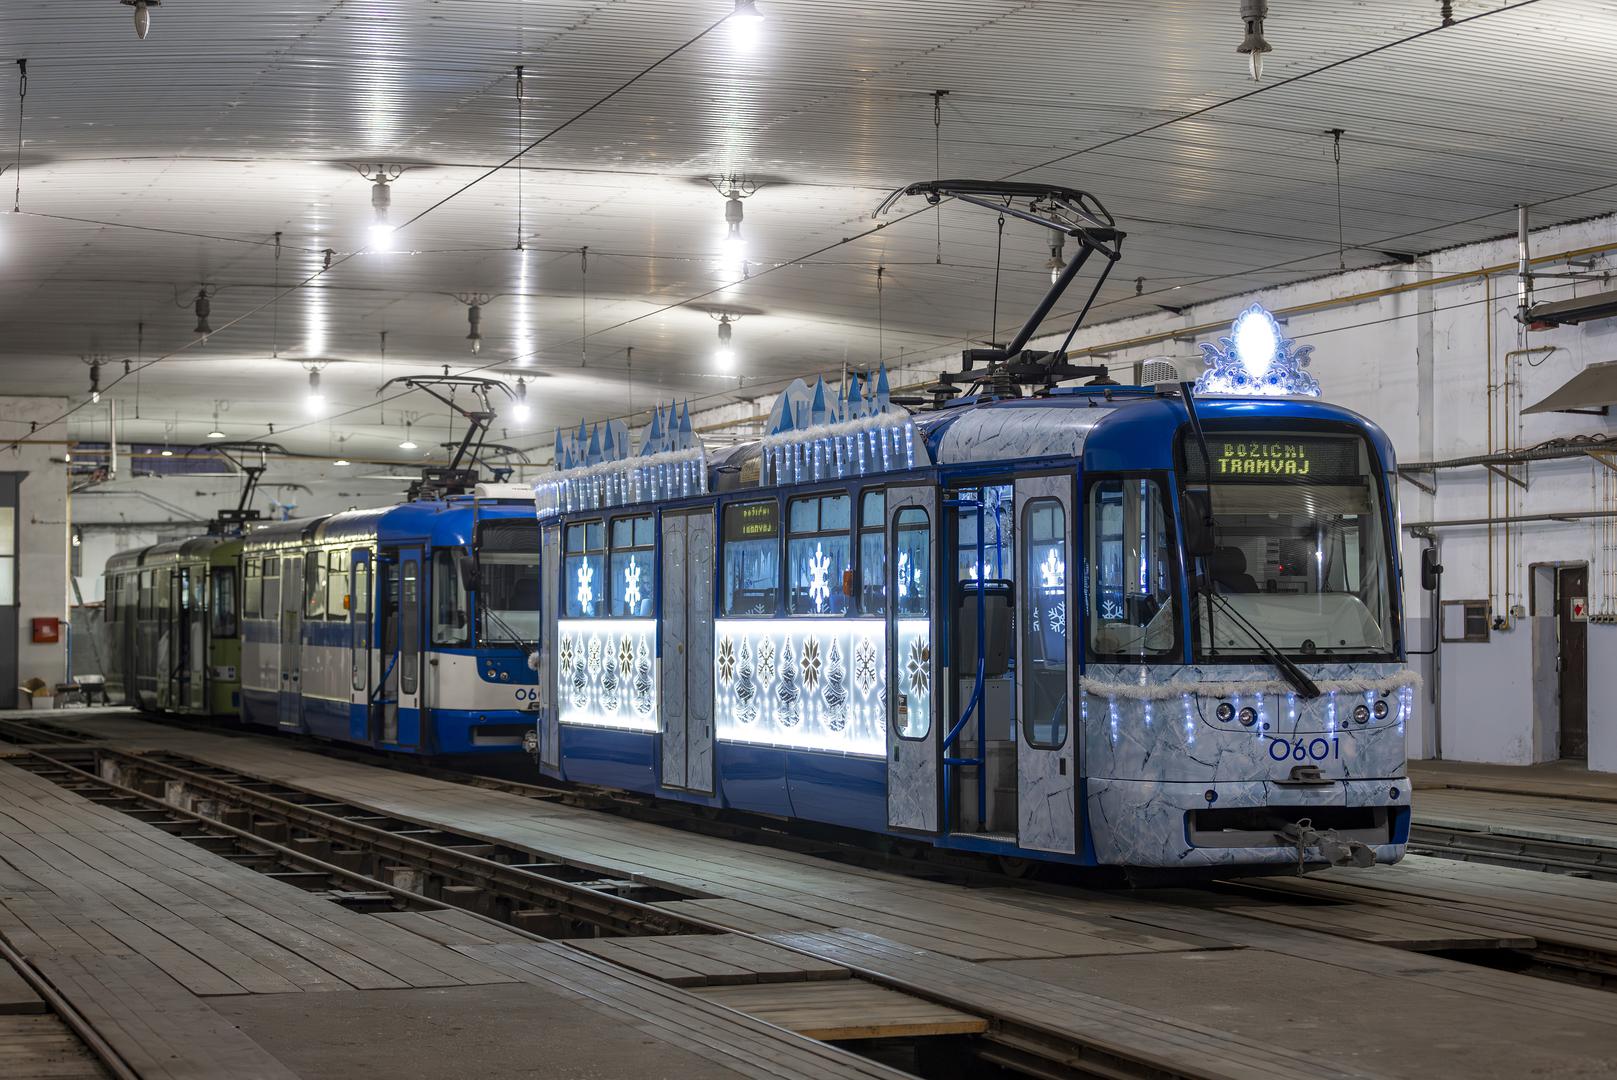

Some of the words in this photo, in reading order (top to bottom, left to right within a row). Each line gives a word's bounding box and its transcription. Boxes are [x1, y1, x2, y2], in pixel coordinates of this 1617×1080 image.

[1218, 458, 1310, 474] TRAMVAJ
[515, 688, 540, 700] 06
[1269, 737, 1339, 761] 0601
